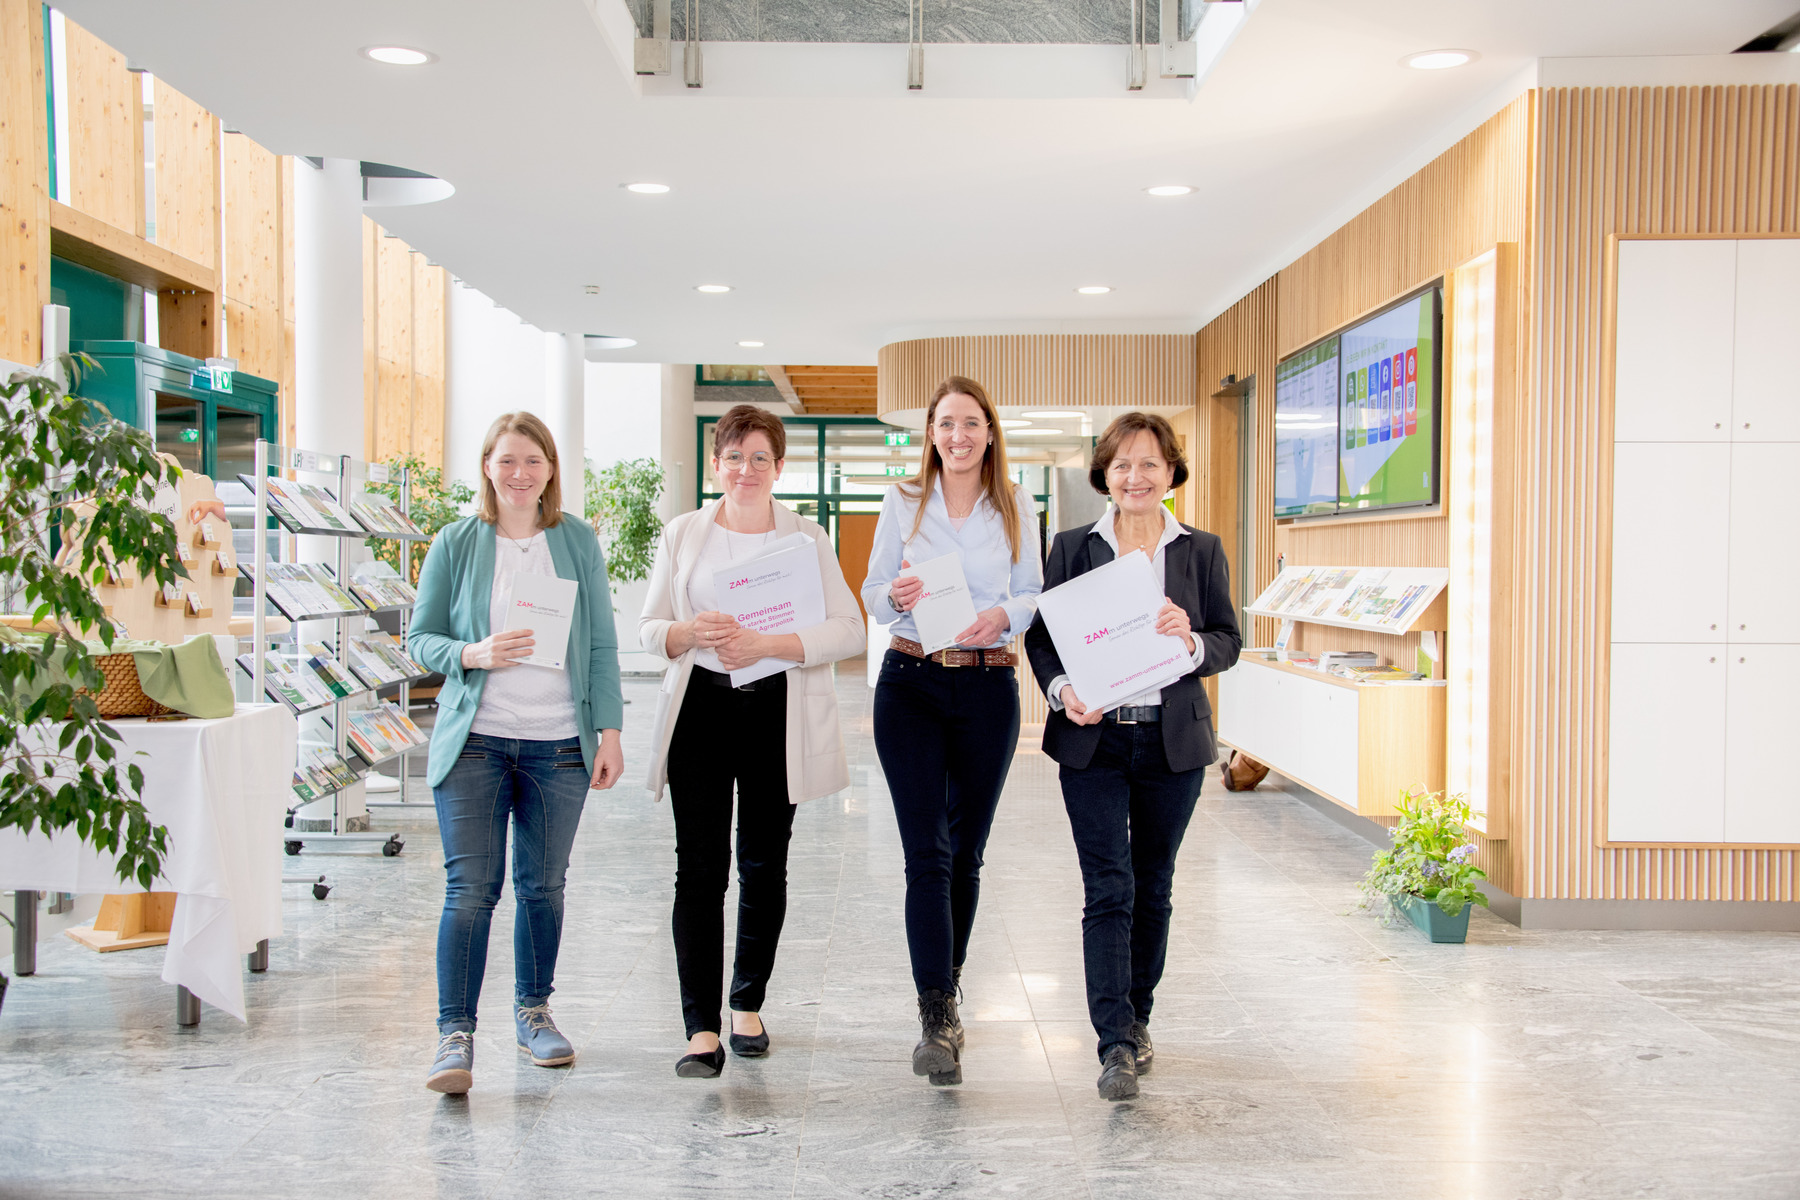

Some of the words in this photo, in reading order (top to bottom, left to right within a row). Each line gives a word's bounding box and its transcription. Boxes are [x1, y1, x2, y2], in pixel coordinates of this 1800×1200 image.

[737, 601, 792, 622] Gemeinsam
[747, 618, 767, 628] starke
[767, 609, 795, 622] Stimmen
[758, 616, 794, 632] Agrarpolitik
[1084, 627, 1116, 645] ZAMm
[1116, 612, 1150, 631] unterwegs
[1109, 653, 1182, 689] www.zamm-unterwegs.at
